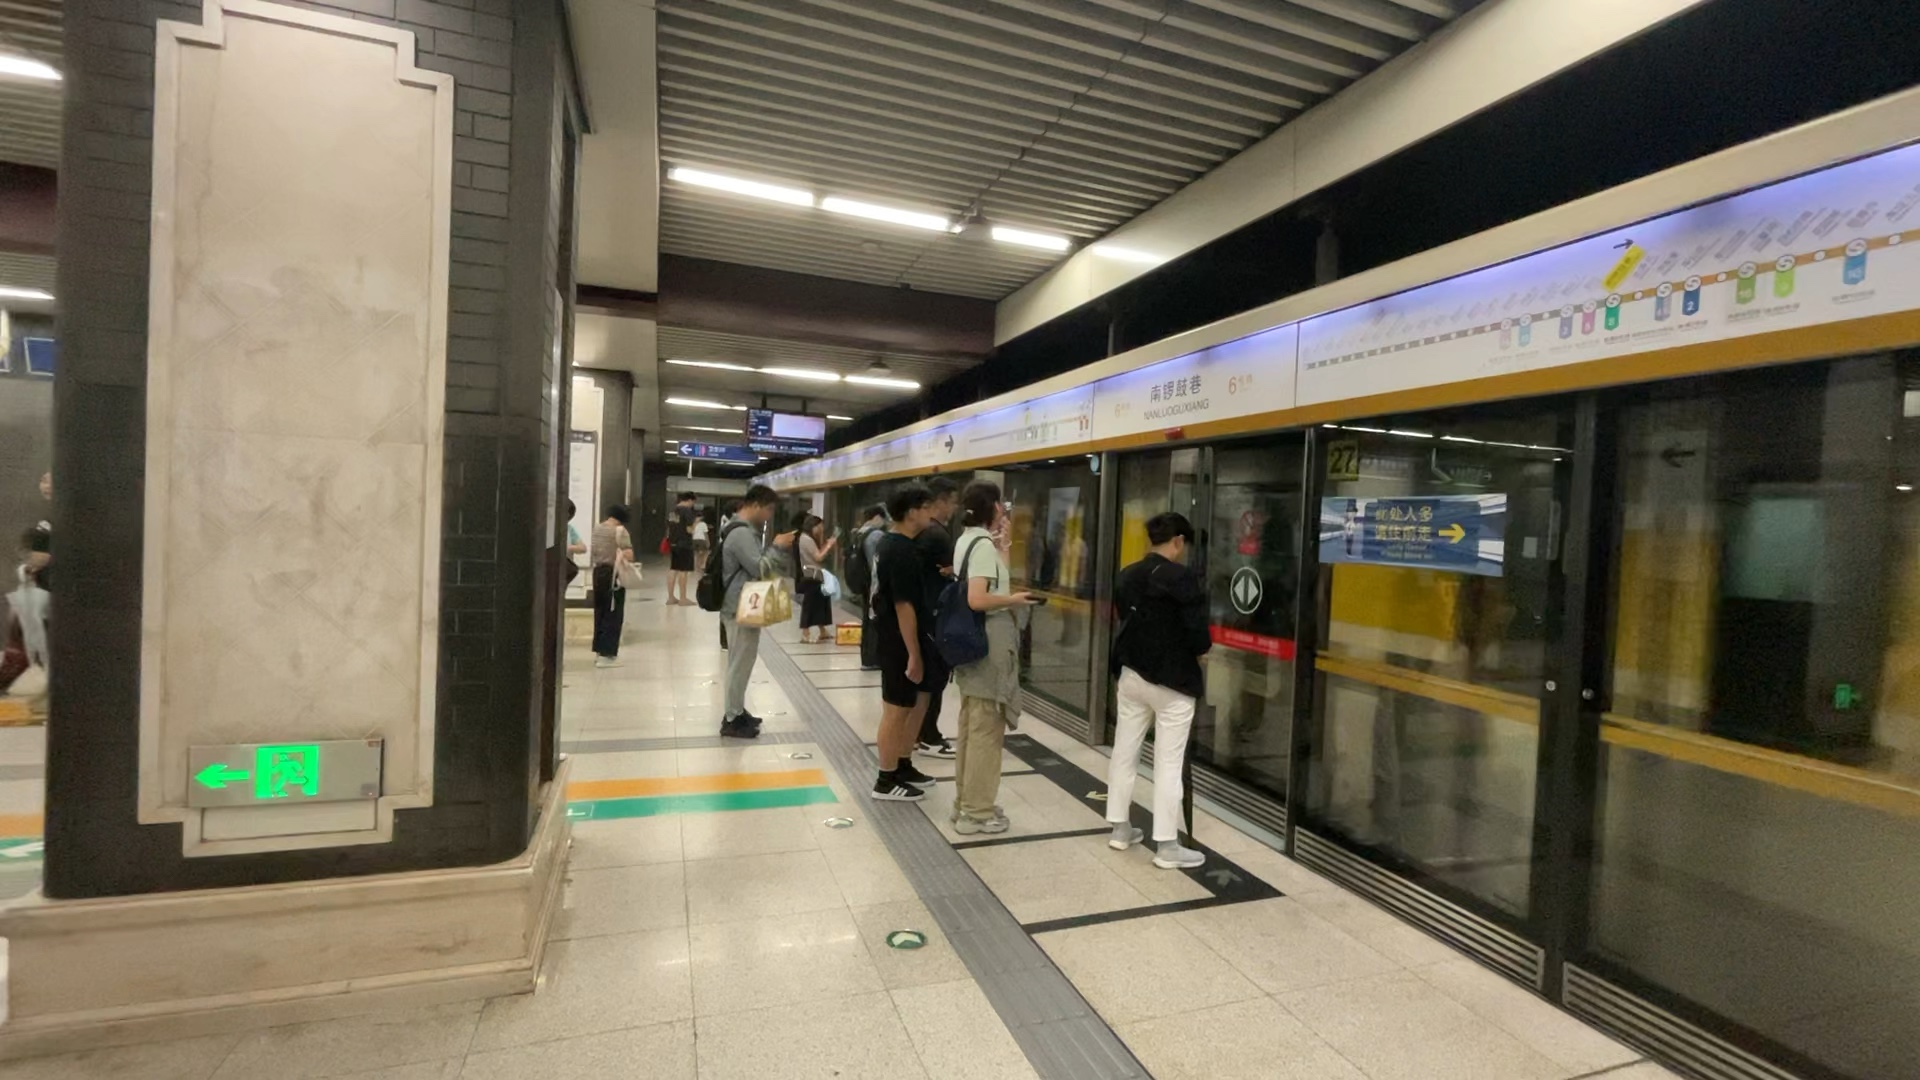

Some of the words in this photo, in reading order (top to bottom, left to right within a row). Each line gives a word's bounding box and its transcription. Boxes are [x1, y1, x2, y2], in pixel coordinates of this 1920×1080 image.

[1687, 301, 1695, 311] 2
[1151, 374, 1201, 403] 南锣鼓巷
[1144, 398, 1209, 420] NANLUOGUXIANG
[1330, 446, 1355, 474] 27
